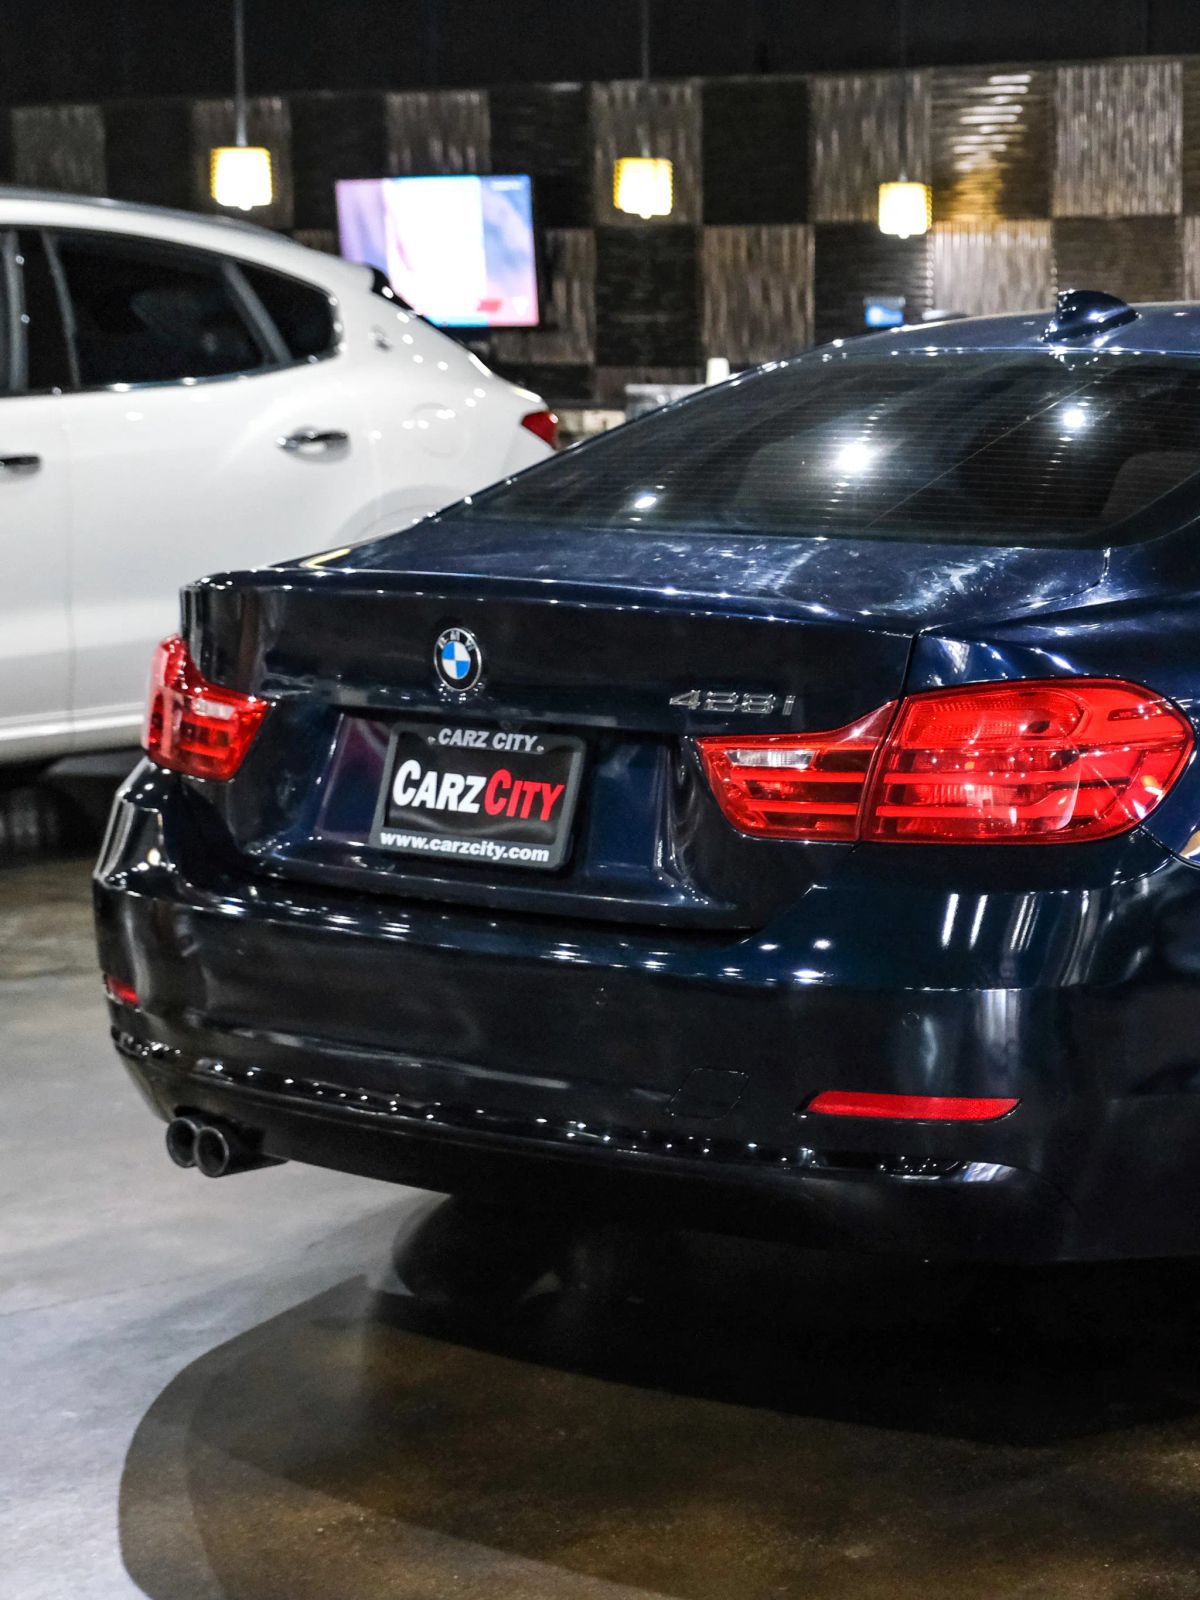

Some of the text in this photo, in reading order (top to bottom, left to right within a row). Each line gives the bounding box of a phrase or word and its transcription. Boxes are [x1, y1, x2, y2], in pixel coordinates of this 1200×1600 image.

[669, 689, 796, 716] 428i
[438, 728, 539, 752] CARZ CITY
[380, 832, 550, 861] www.carzcity.com
